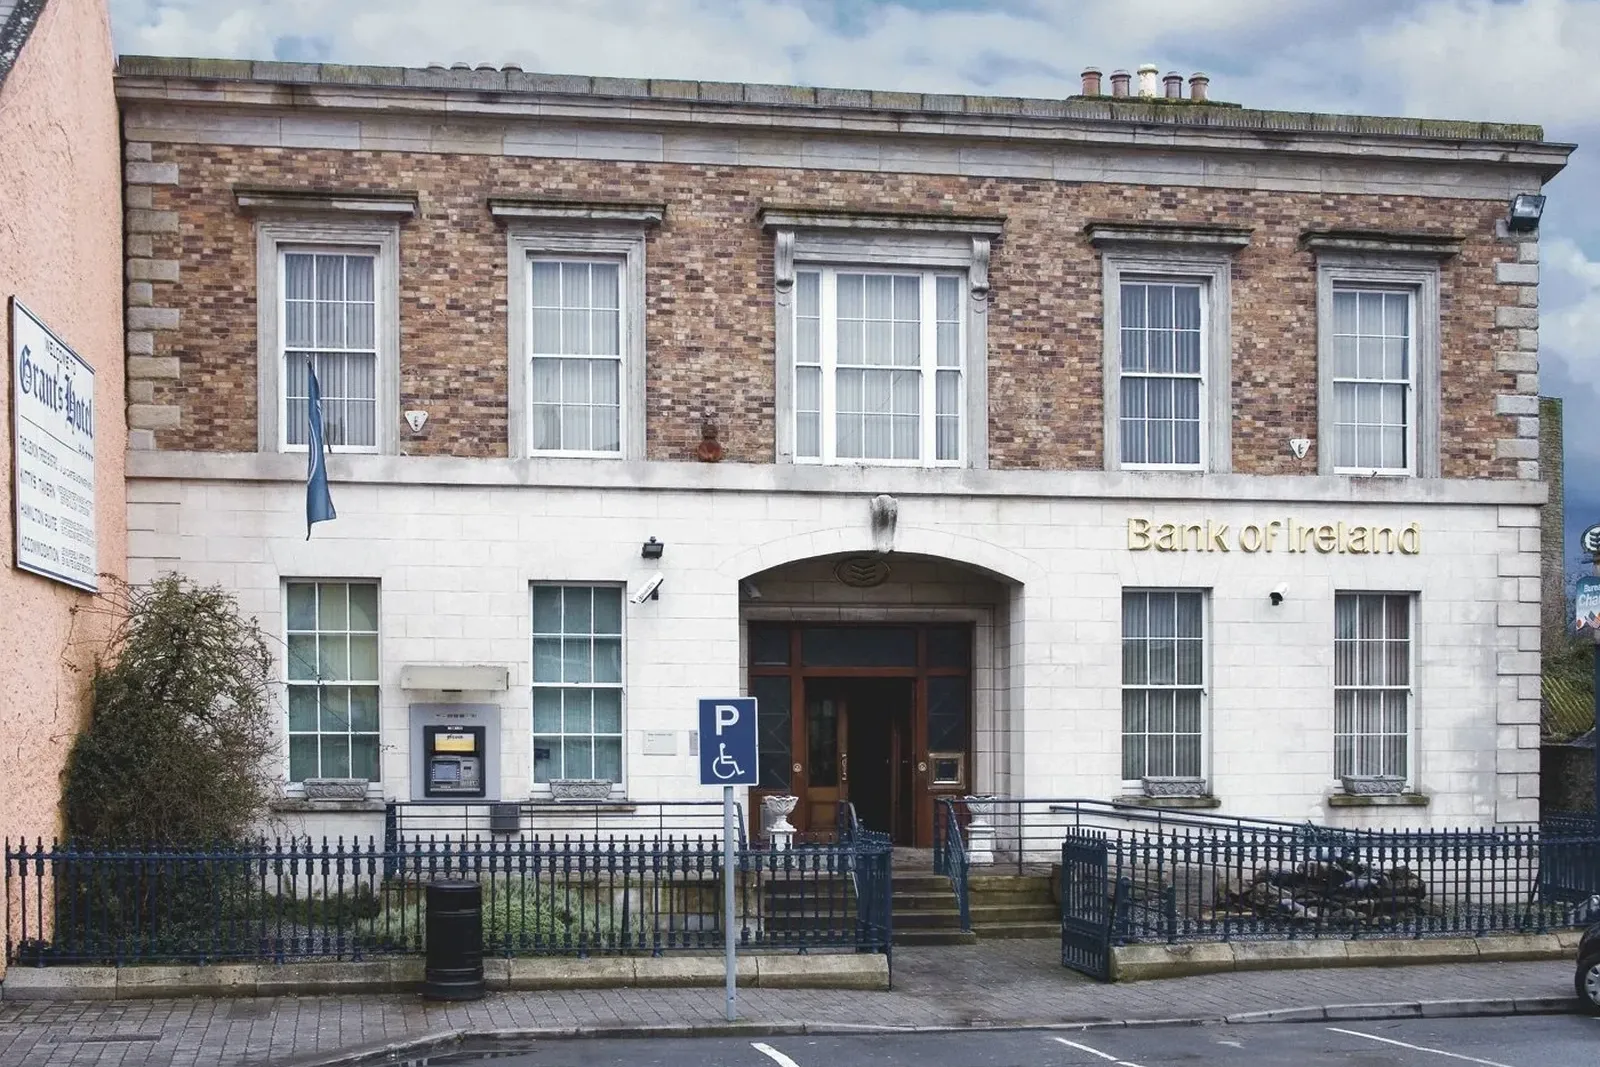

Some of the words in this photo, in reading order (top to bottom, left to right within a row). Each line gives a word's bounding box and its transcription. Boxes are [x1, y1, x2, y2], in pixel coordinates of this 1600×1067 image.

[20, 345, 63, 412] Grant's
[65, 374, 93, 439] Hotel
[1127, 518, 1230, 552] Bank
[1239, 521, 1281, 553] of
[1288, 517, 1420, 555] Ireland
[1579, 593, 1600, 607] Cha
[715, 705, 740, 736] P
